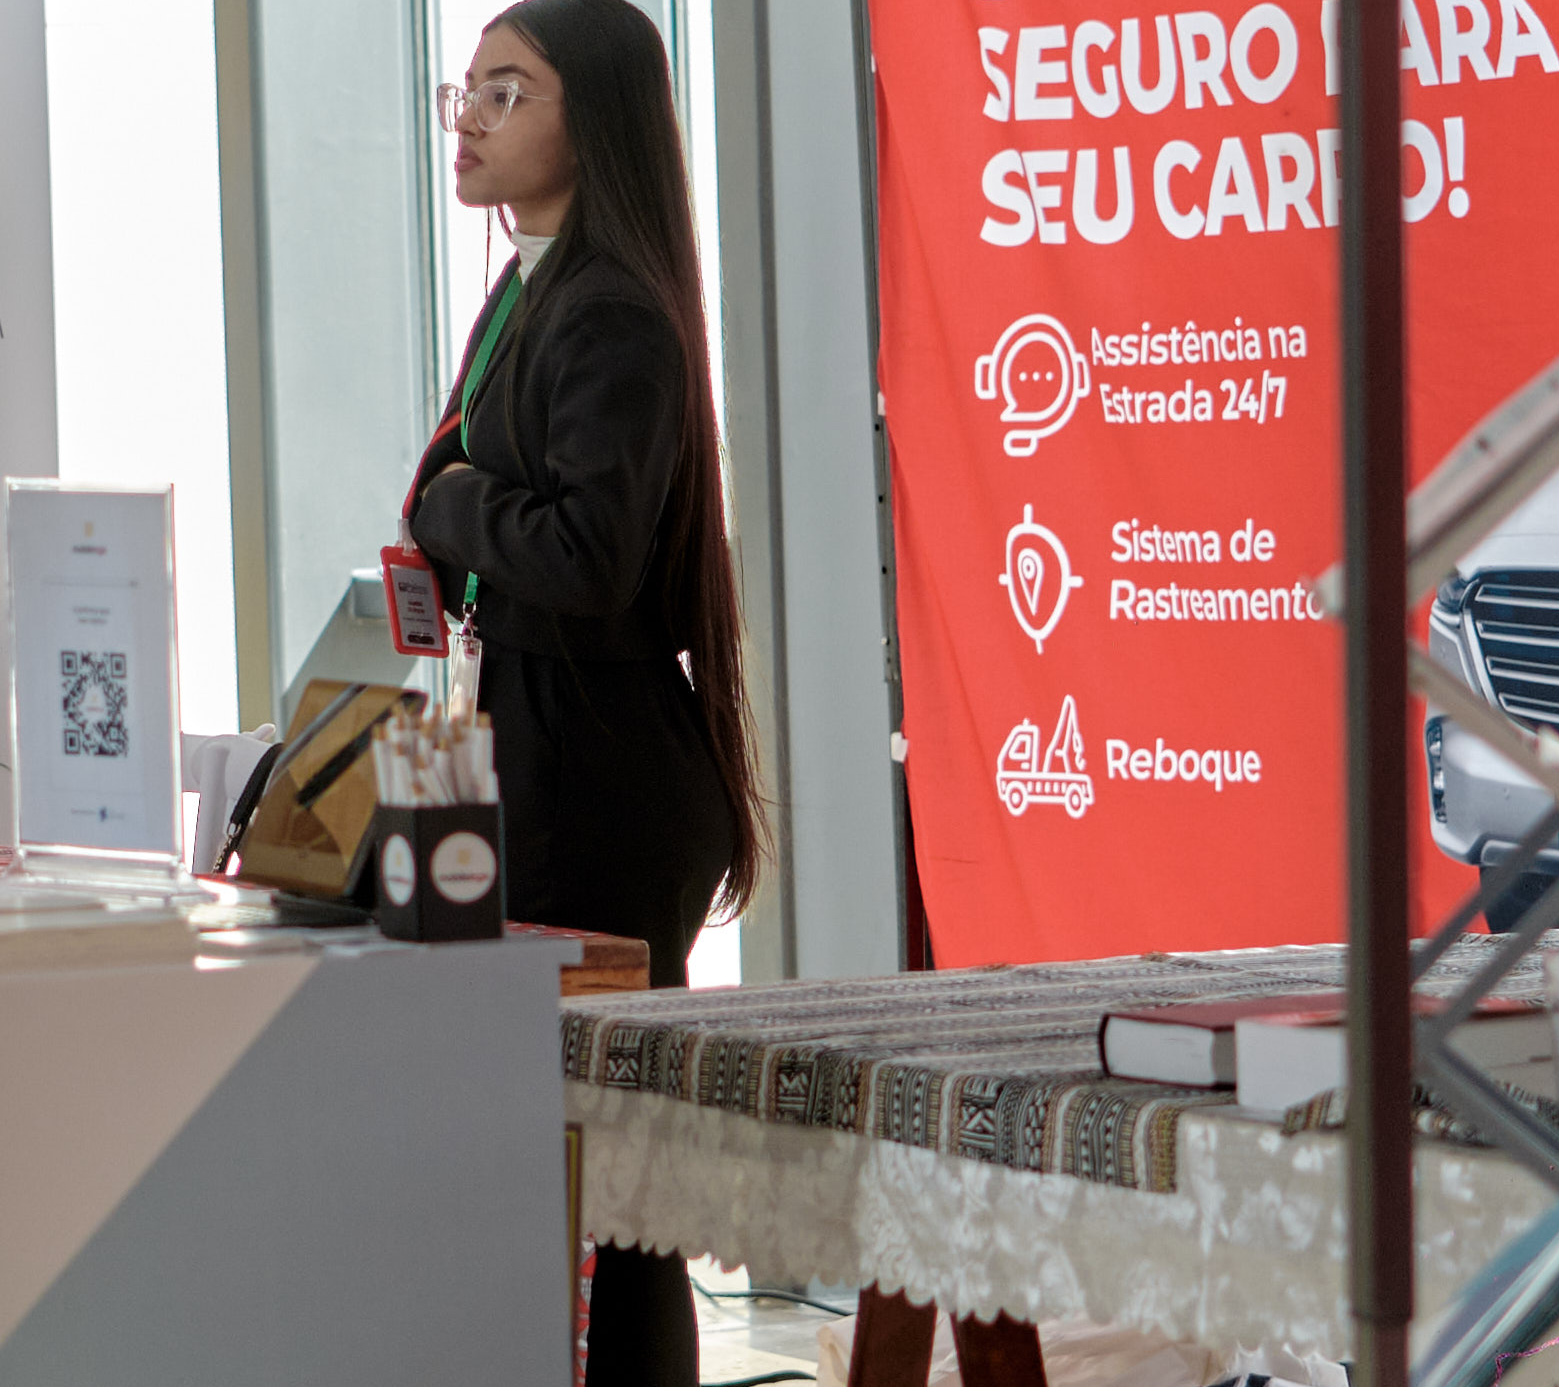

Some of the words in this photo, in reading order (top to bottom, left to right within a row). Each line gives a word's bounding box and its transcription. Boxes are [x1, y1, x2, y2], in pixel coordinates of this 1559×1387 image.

[978, 2, 1299, 122] SEGURO
[980, 146, 1135, 247] SEU
[1090, 316, 1262, 366] Assistência
[1267, 324, 1308, 359] na
[1099, 379, 1213, 424] Estrada
[1219, 369, 1287, 425] 24/7
[1111, 518, 1221, 563] Sistema
[1229, 518, 1276, 562] de
[1109, 578, 1325, 621] Rastreamento
[1106, 737, 1262, 793] Reboque
